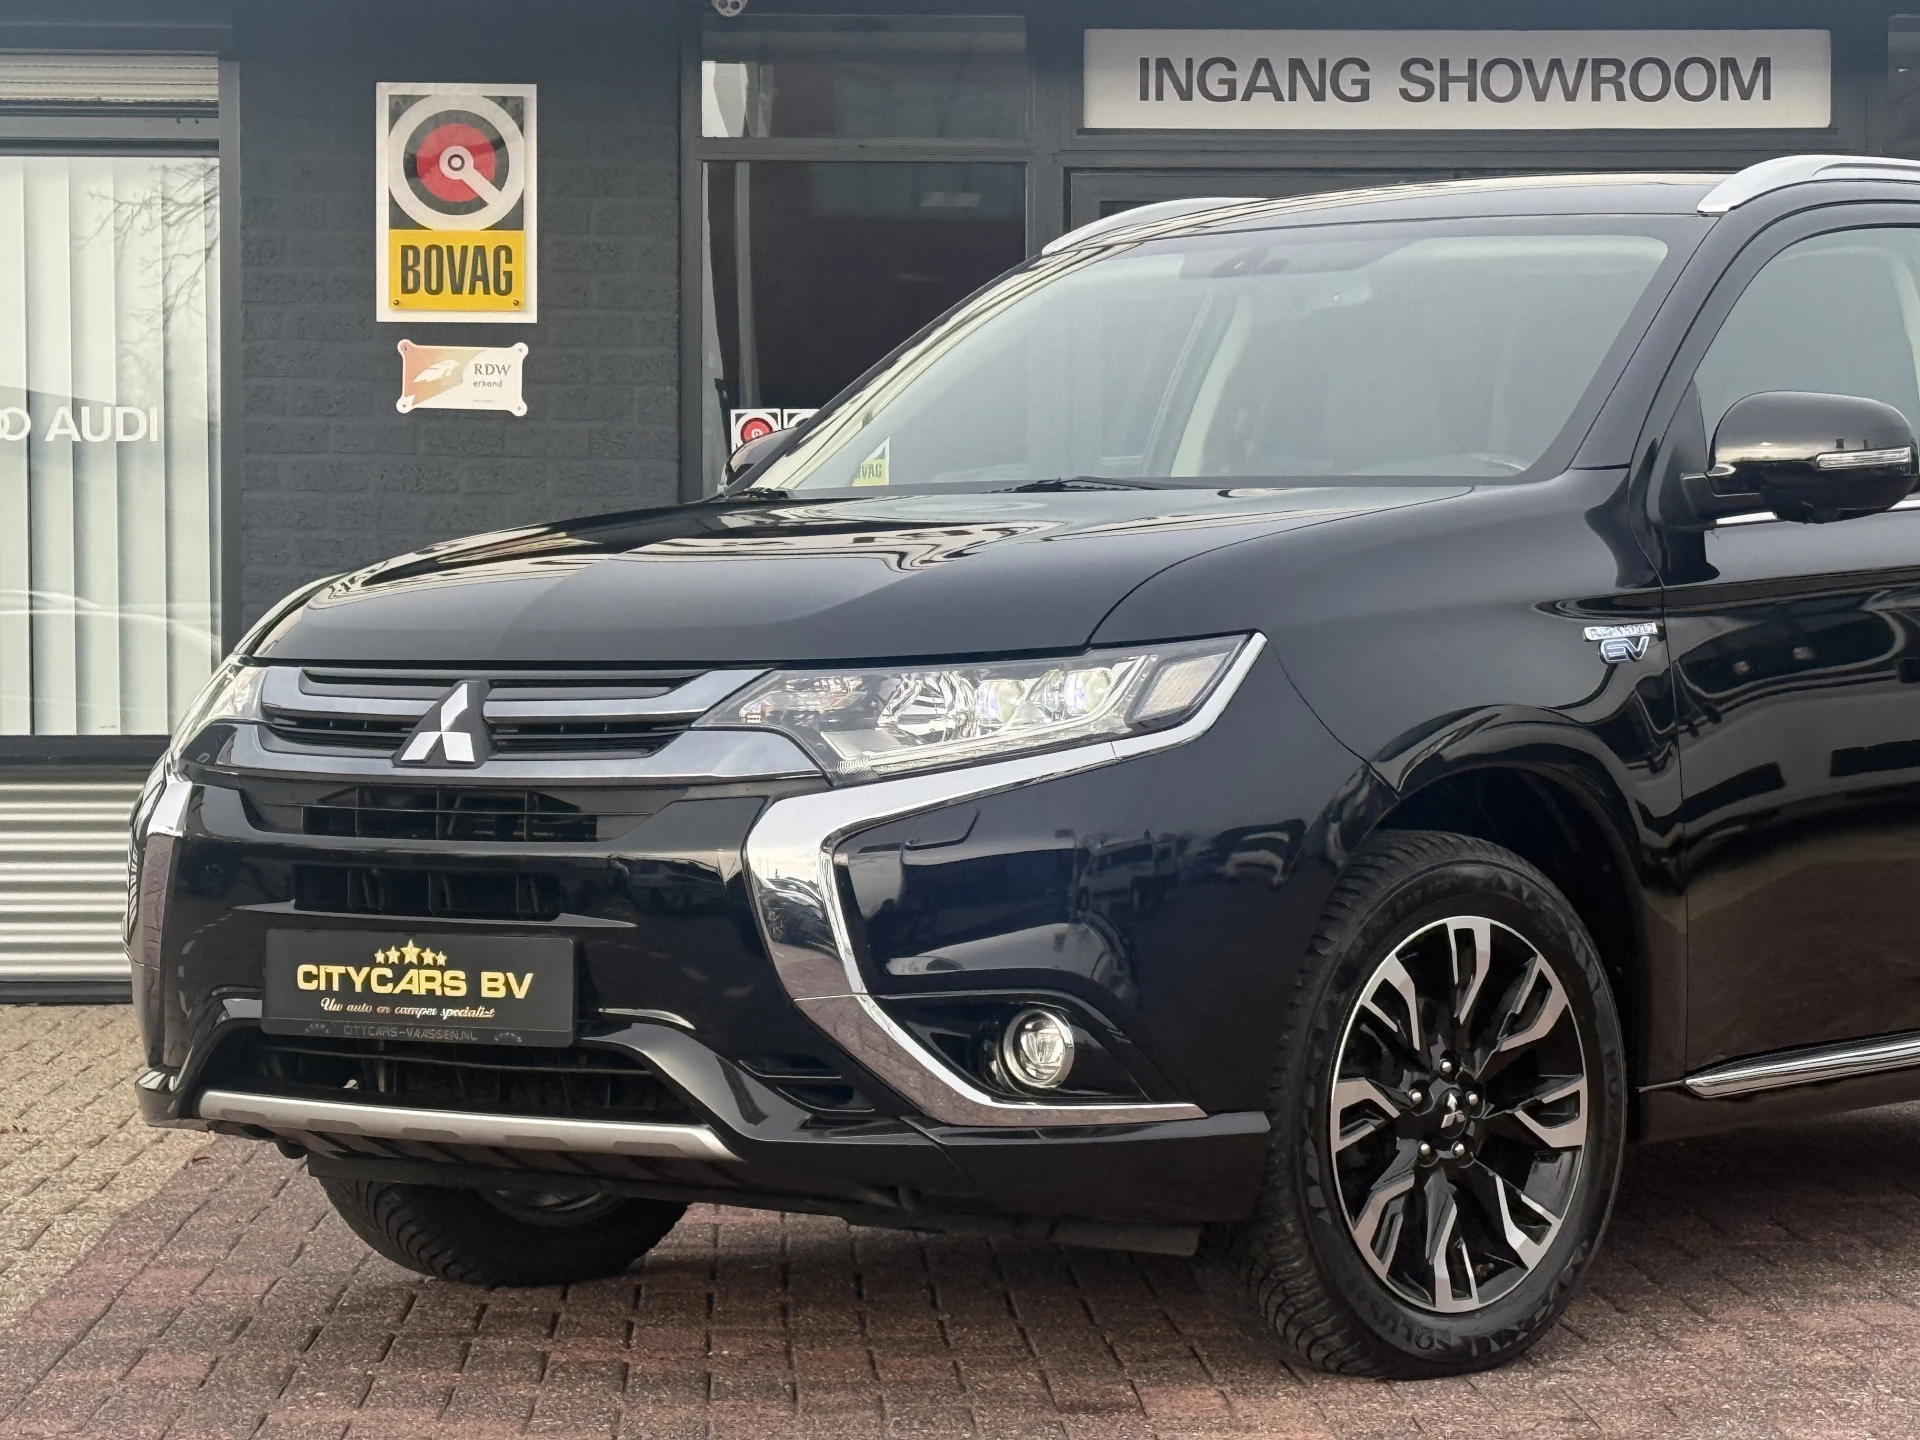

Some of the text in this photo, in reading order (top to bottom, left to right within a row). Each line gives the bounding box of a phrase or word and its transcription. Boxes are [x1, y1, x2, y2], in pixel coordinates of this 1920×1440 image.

[1139, 56, 1772, 102] INGANG SHOWROOM
[400, 244, 513, 297] BOVAG
[473, 380, 502, 388] erkend
[474, 363, 511, 376] RDW
[44, 405, 158, 443] AUDI
[1600, 635, 1650, 663] EV
[296, 964, 534, 999] CITYCARS BV
[320, 997, 496, 1020] Uw auto en camper specialist
